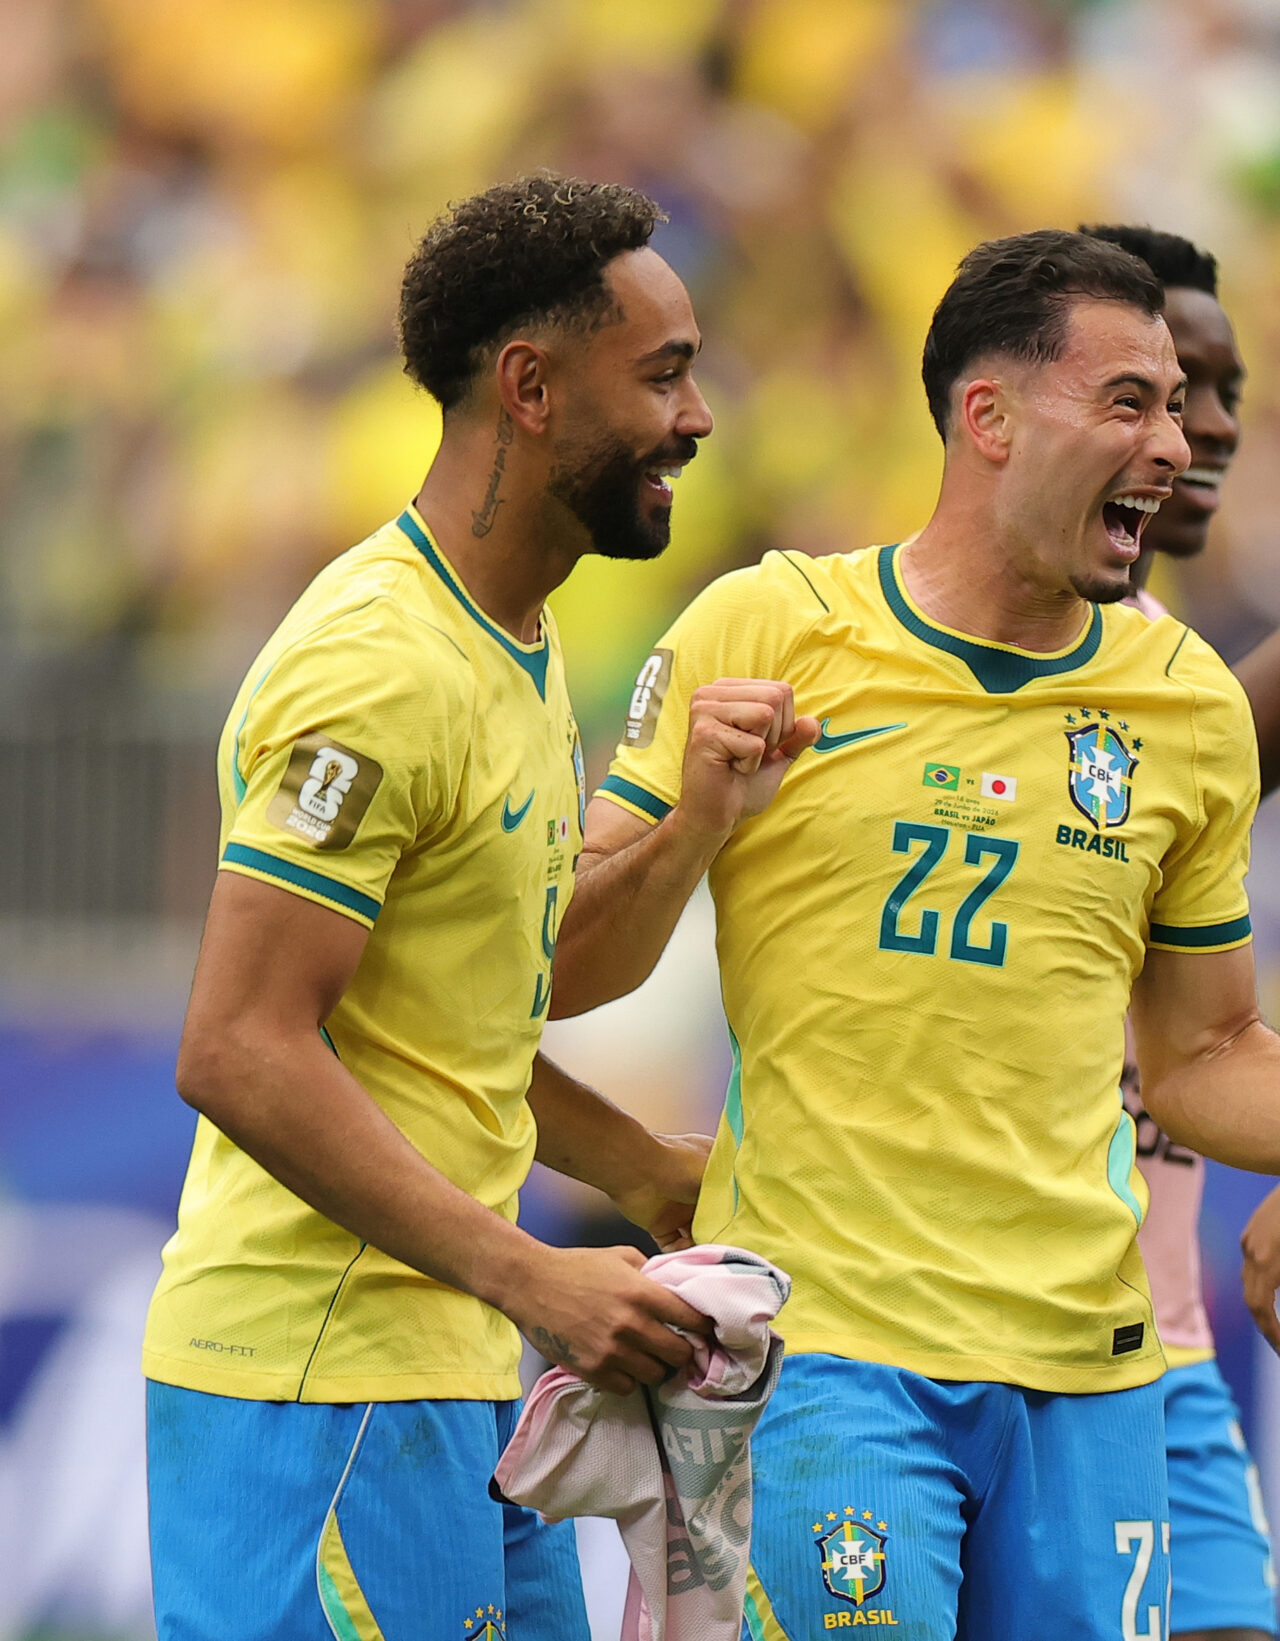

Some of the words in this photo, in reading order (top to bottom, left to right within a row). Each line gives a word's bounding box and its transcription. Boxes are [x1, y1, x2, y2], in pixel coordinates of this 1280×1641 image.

[1089, 764, 1114, 783] CBF
[308, 799, 326, 814] FIFA
[934, 808, 960, 819] BRASIL
[285, 814, 328, 842] 2026
[292, 807, 316, 826] WORLD
[316, 819, 332, 832] CUP
[1055, 824, 1130, 864] BRASIL
[878, 819, 1022, 969] 22
[188, 1338, 258, 1357] AERO-FIT
[840, 1553, 866, 1566] CBF
[1114, 1520, 1172, 1641] 2
[823, 1609, 899, 1630] BRASIL
